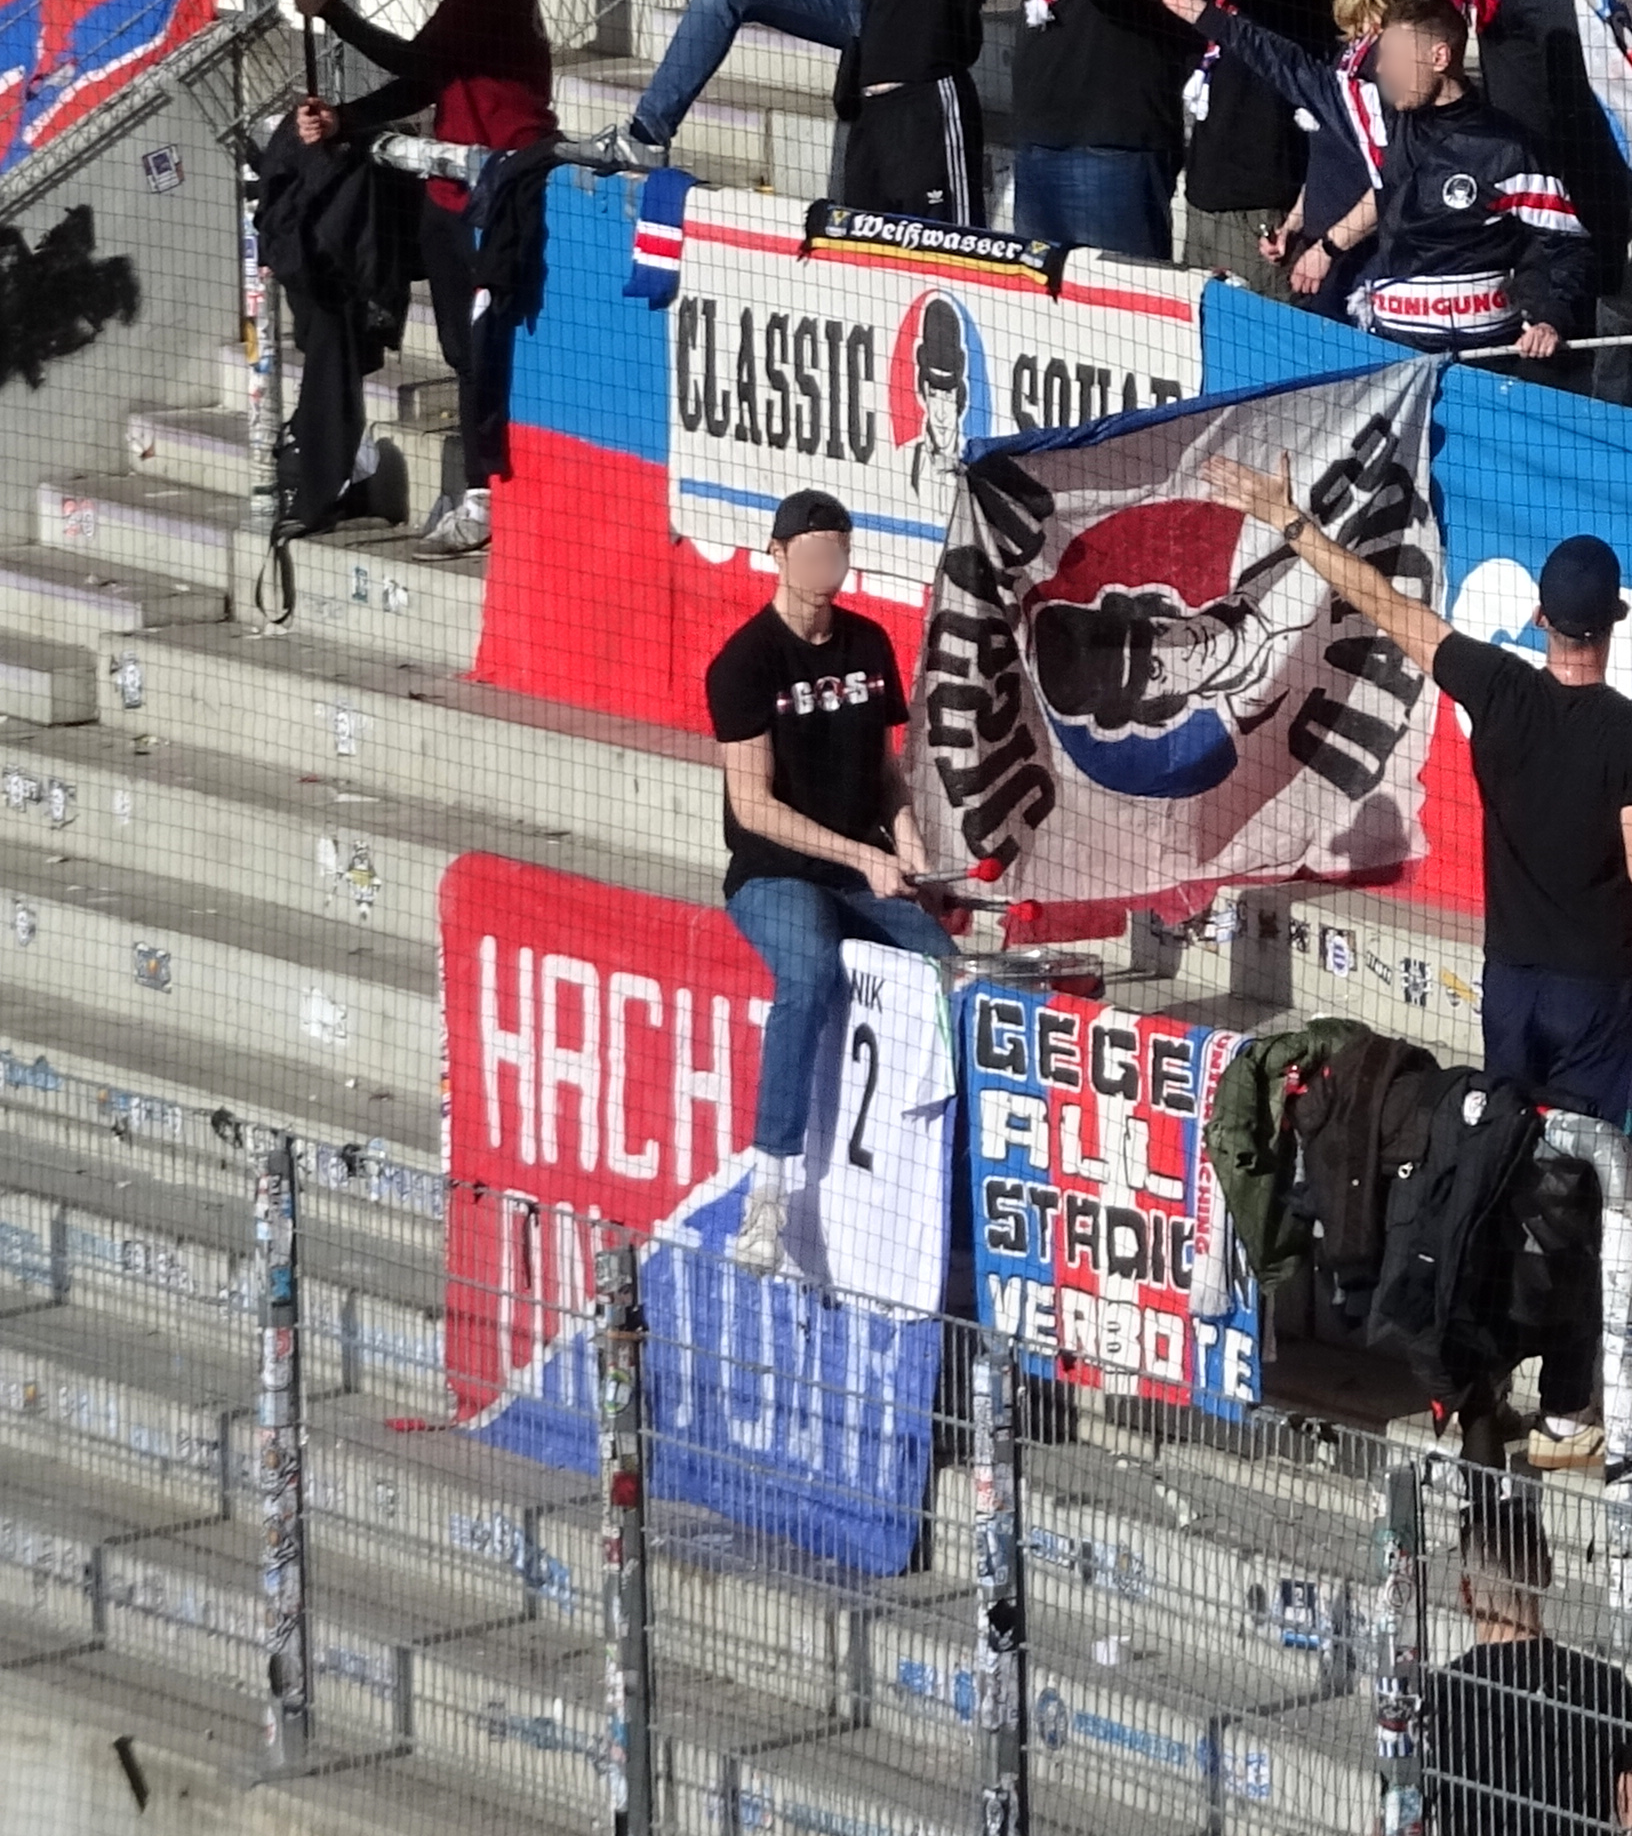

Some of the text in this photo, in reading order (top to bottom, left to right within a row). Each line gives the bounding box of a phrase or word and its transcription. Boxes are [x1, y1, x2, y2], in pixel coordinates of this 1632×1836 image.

[677, 298, 873, 465] CLASSIC
[852, 1022, 877, 1172] 2
[977, 994, 1196, 1117] GEGE
[979, 1090, 1186, 1200] ALL
[985, 1272, 1260, 1404] VERBOTE
